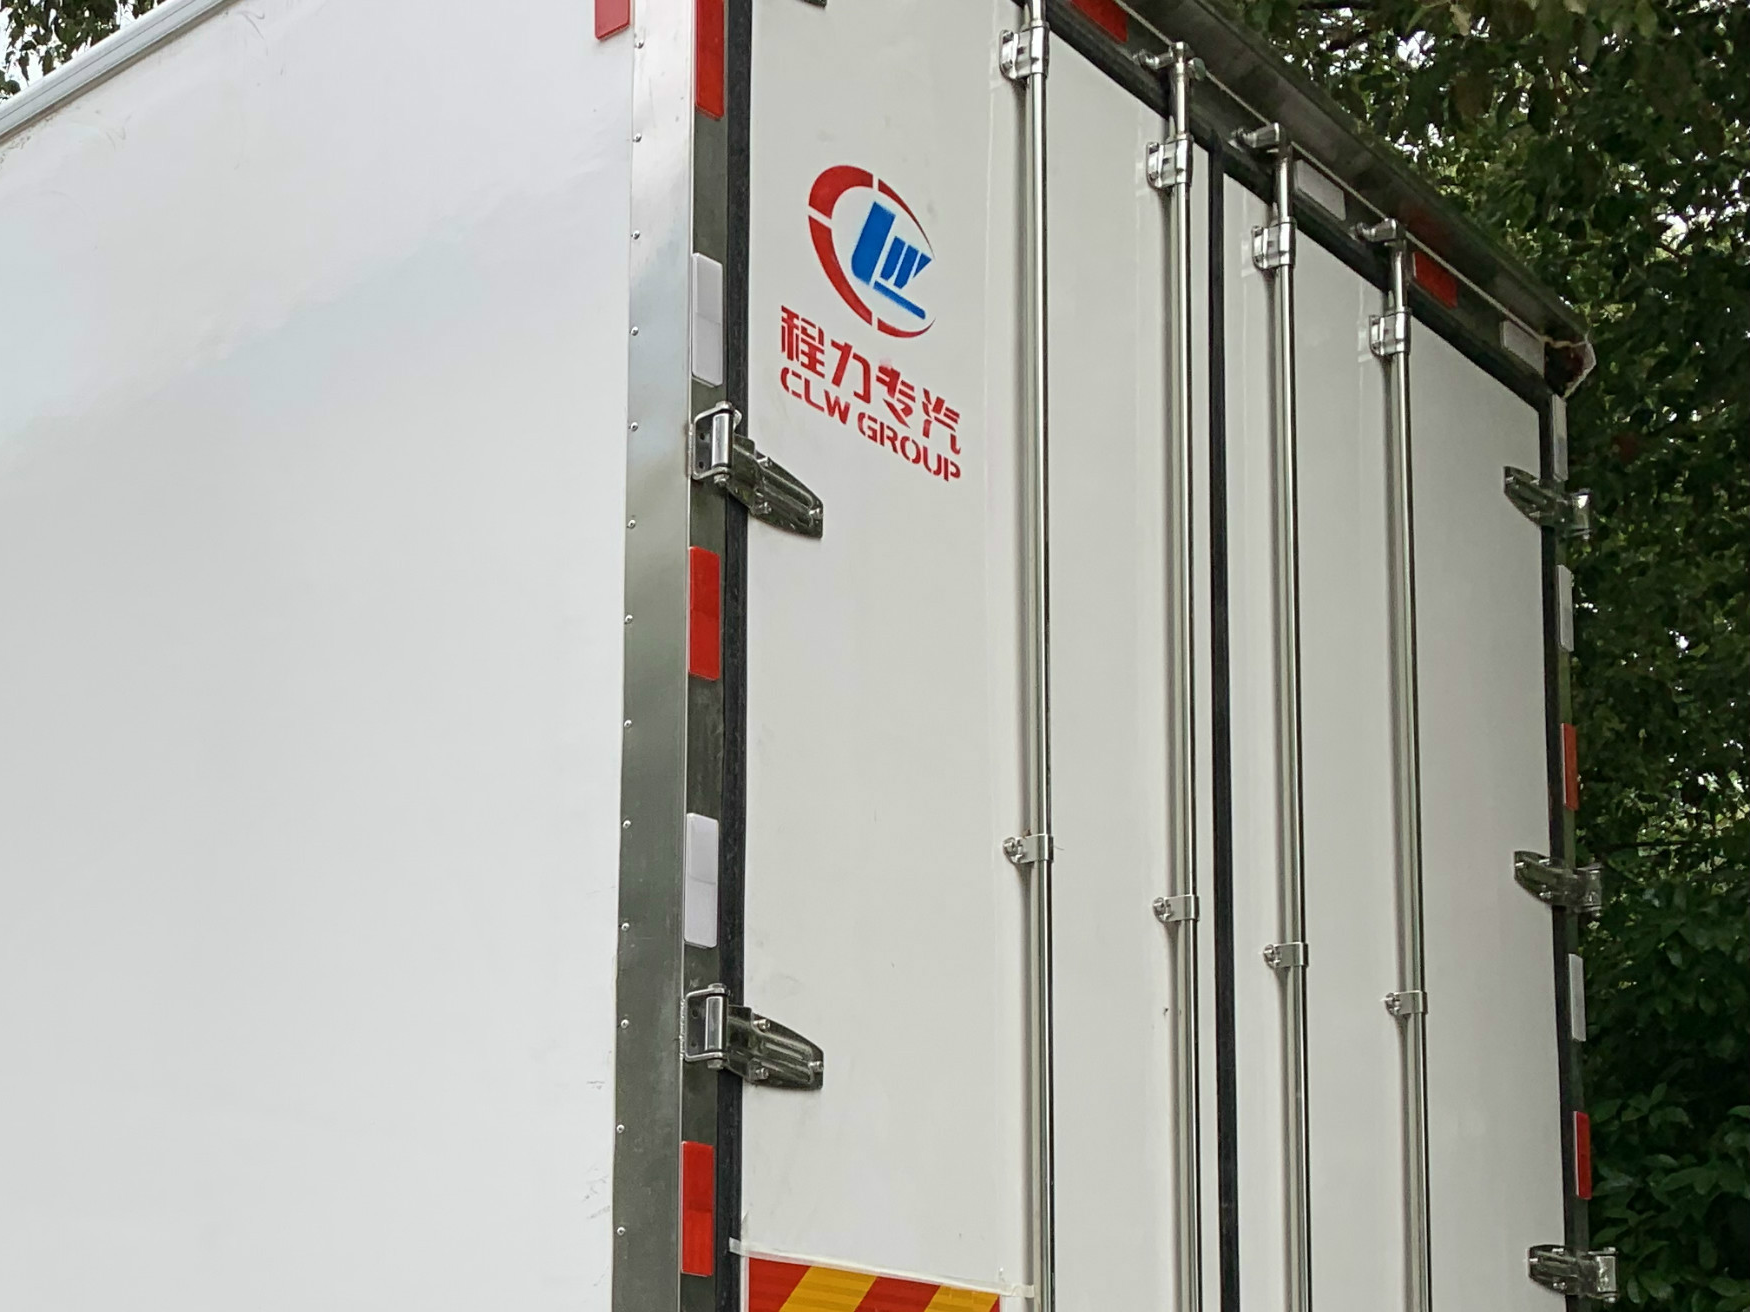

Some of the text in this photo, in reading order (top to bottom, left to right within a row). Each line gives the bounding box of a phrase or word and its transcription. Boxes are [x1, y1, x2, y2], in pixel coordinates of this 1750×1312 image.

[780, 305, 961, 456] 程力专汽
[780, 367, 961, 482] CLW GROUP
